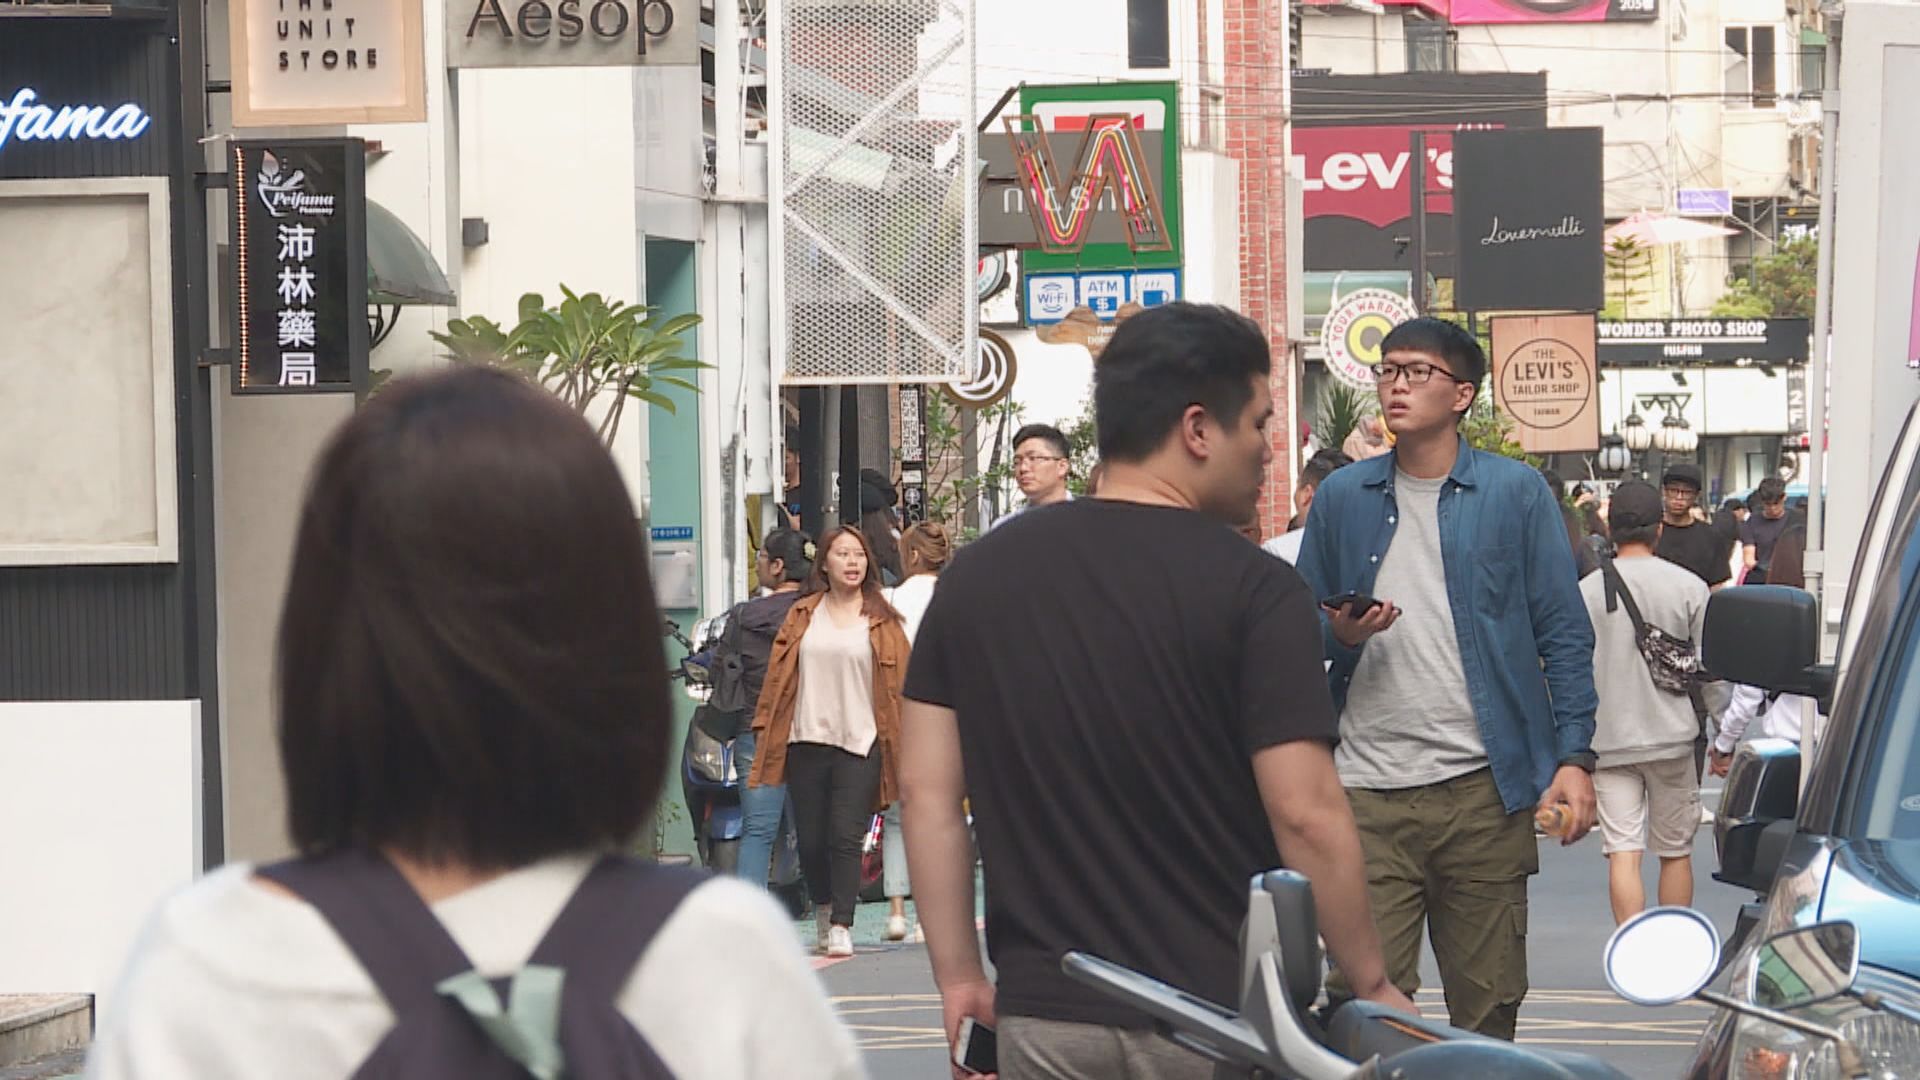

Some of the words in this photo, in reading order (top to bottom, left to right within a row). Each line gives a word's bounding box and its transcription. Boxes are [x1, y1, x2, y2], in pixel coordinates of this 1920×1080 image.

[277, 18, 355, 39] UNIT
[466, 0, 674, 55] Aesop
[279, 49, 377, 70] STORE
[0, 87, 151, 150] fama
[1088, 280, 1118, 292] ATM
[276, 224, 317, 387] 沛林藥局
[1599, 321, 1664, 337] WONDER
[1671, 321, 1722, 336] PHOTO
[1726, 320, 1767, 335] SHOP
[1533, 349, 1556, 359] THE
[1514, 361, 1574, 381] LEVI'S
[1513, 384, 1548, 395] TAILOR
[1551, 382, 1580, 393] SHOP
